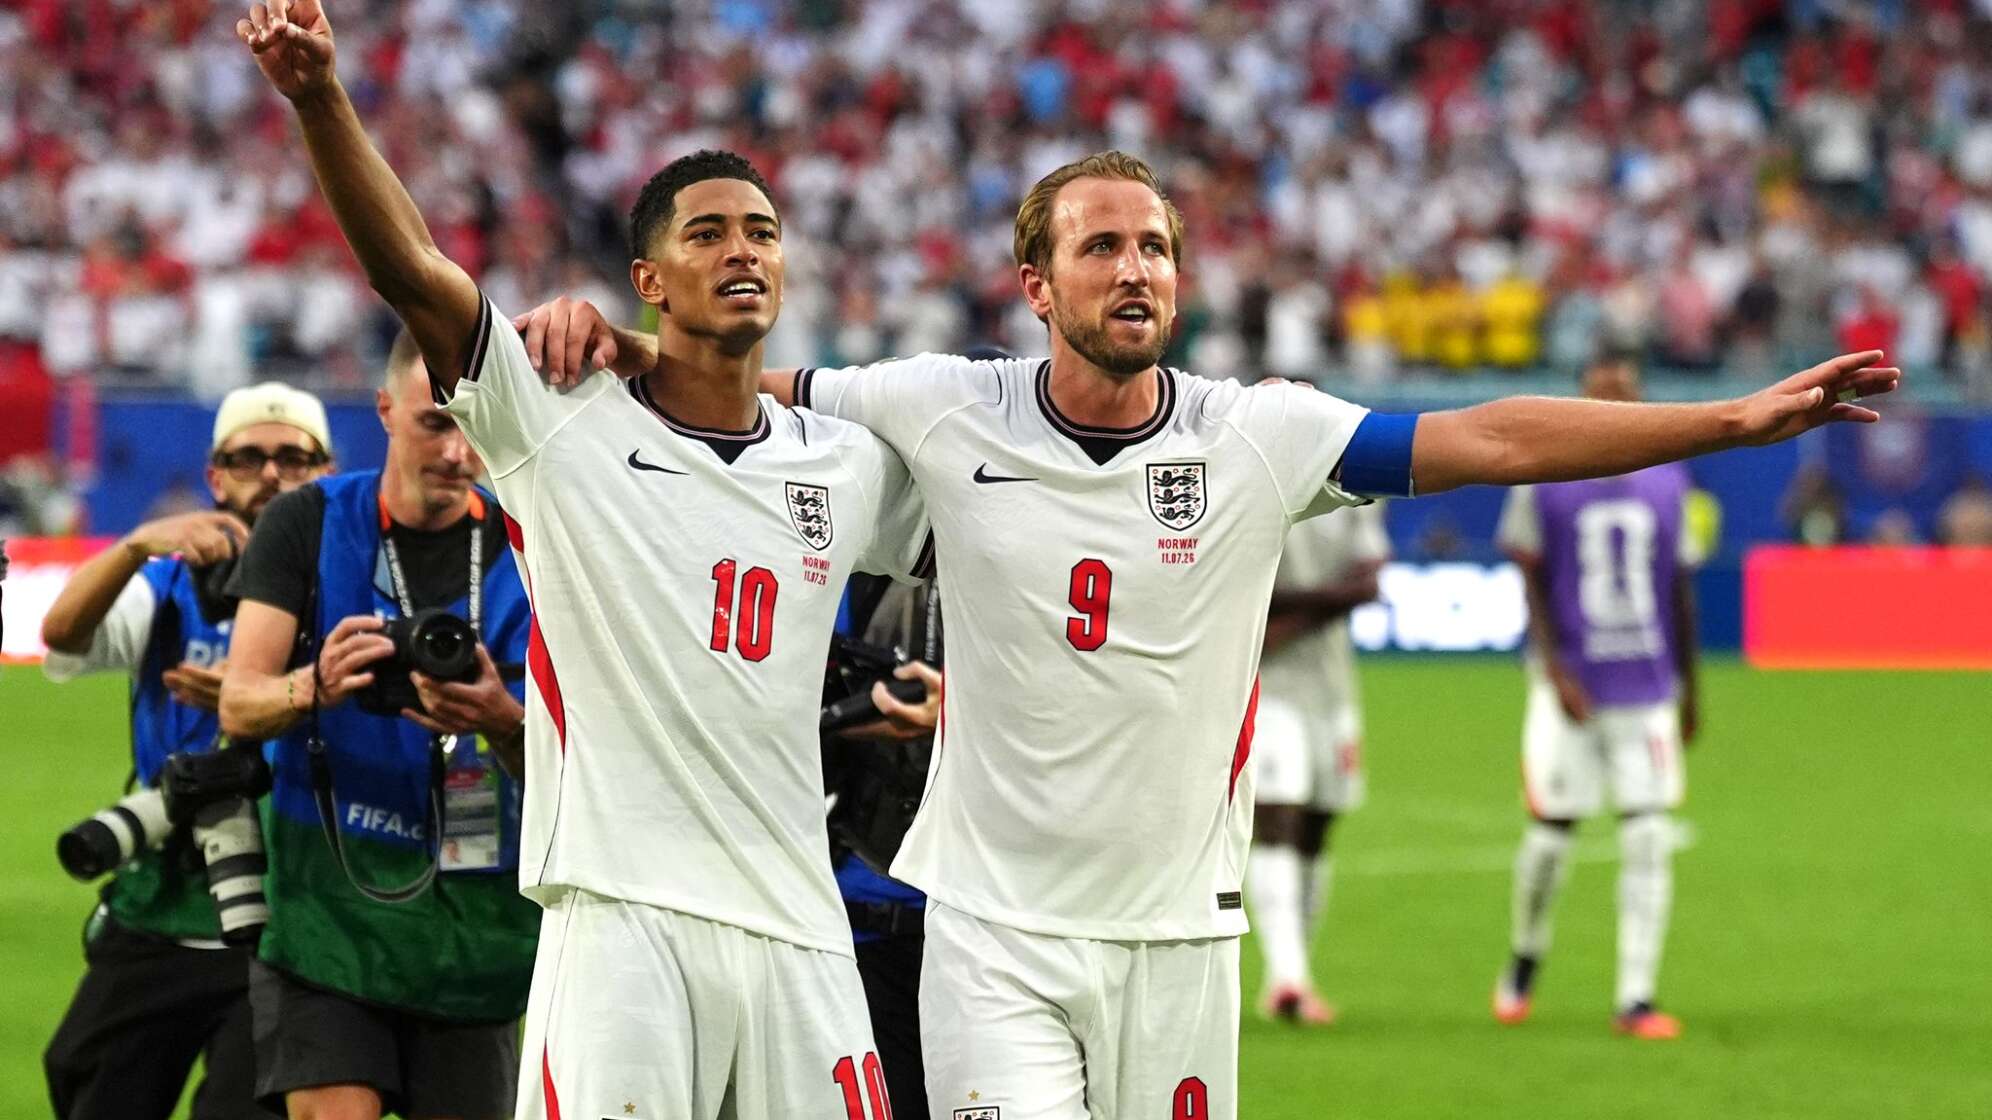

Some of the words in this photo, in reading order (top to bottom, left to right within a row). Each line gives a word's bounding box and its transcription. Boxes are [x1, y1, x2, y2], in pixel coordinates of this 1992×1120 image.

[1158, 538, 1199, 549] NORWAY
[1161, 553, 1194, 564] 11.07.26
[802, 555, 830, 571] NORWAY
[710, 558, 779, 662] 10
[1066, 558, 1112, 652] 9
[347, 803, 425, 840] FIFA.c
[832, 1051, 894, 1120] 10
